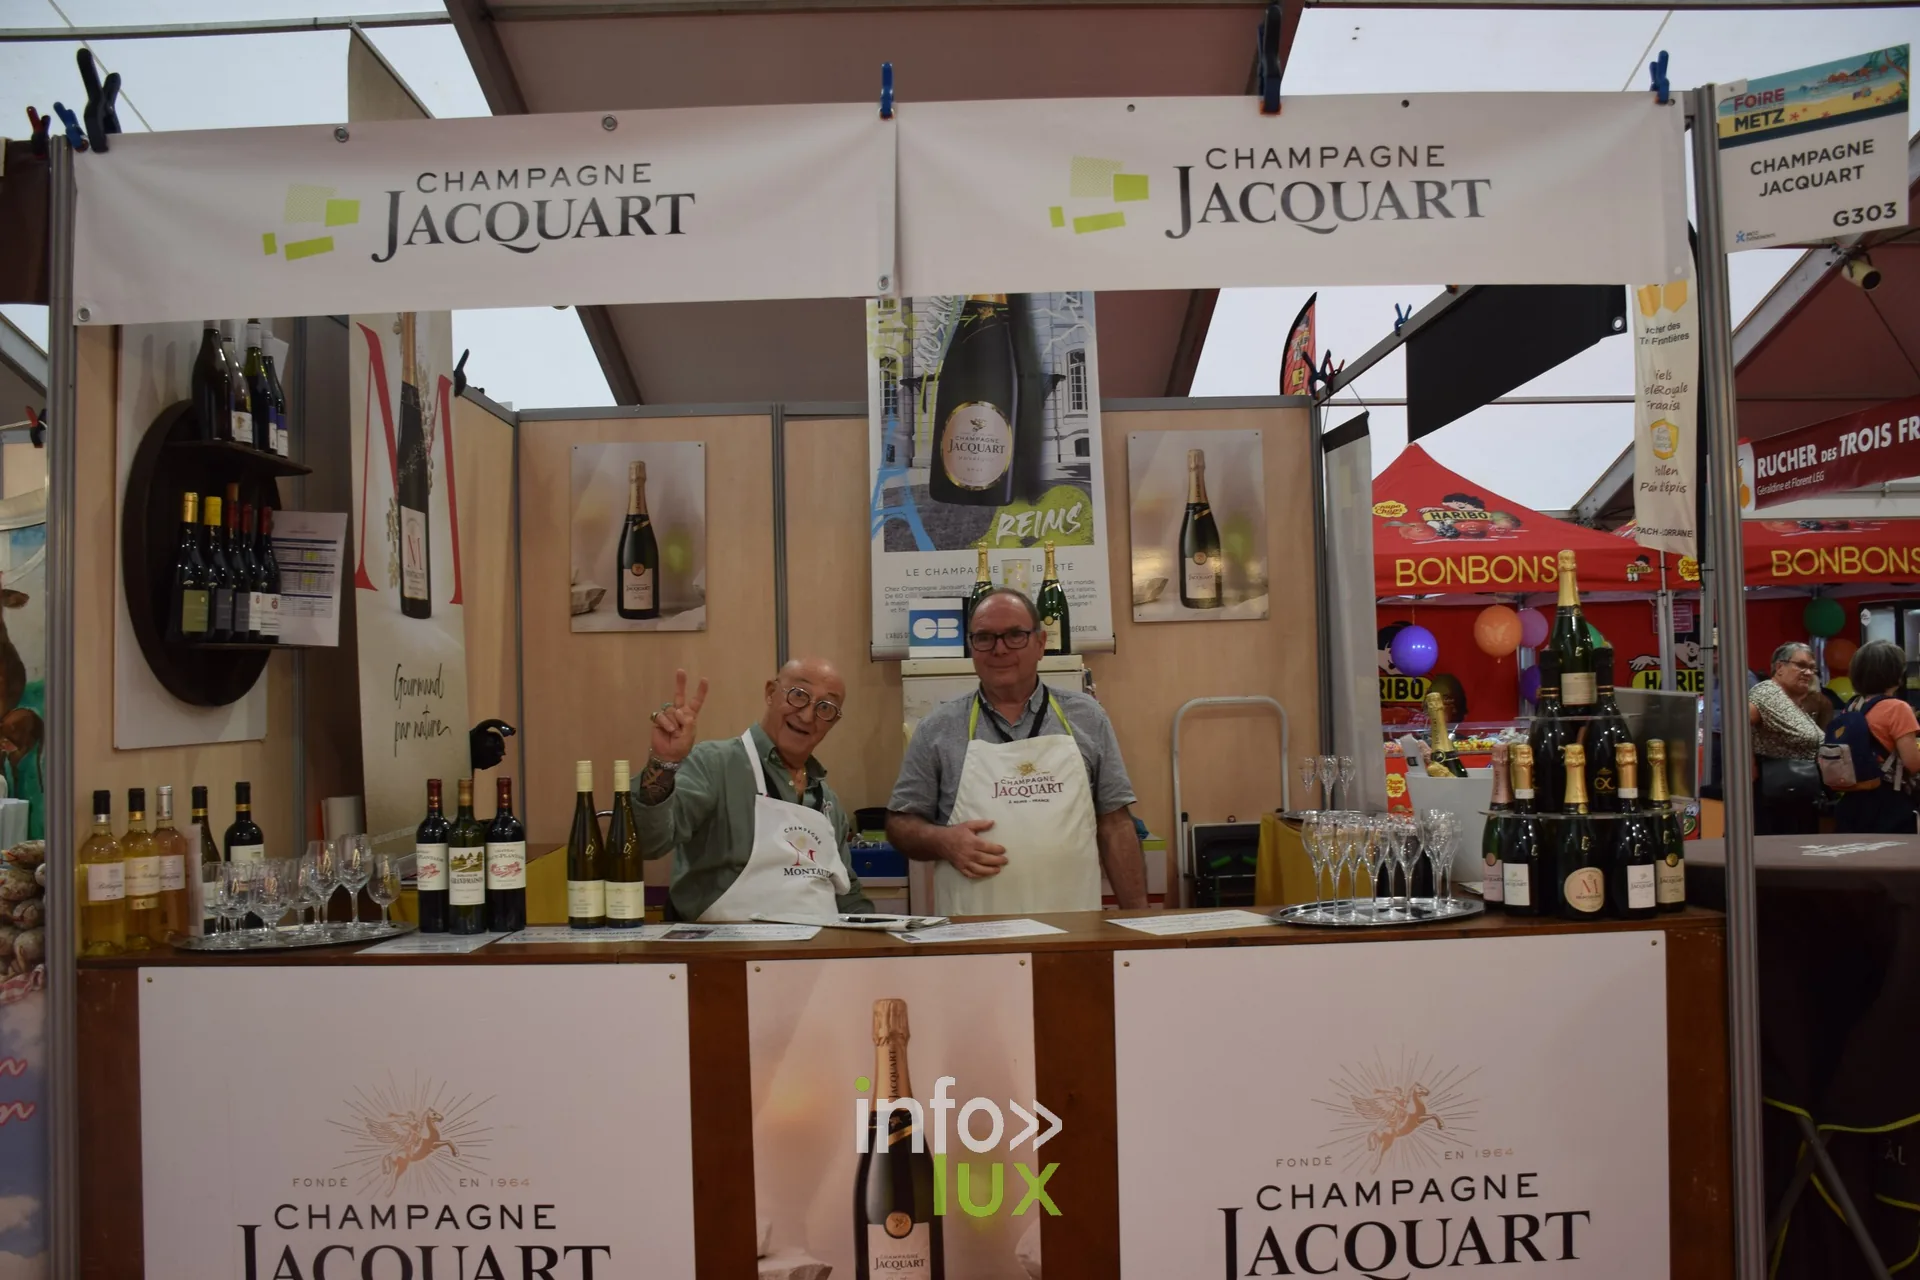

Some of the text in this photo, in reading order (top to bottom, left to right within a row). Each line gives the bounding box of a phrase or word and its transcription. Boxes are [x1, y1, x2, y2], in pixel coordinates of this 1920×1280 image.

[1734, 108, 1785, 132] METZ
[1205, 145, 1446, 170] CHAMPAGNE
[1750, 139, 1875, 175] CHAMPAGNE
[416, 163, 652, 193] CHAMPAGNE
[1759, 164, 1865, 197] JACQUART
[1165, 165, 1492, 240] JACQUART
[1833, 202, 1897, 227] G303
[371, 190, 696, 263] JACQUART
[946, 438, 1006, 454] JACQUART
[1757, 444, 1818, 479] RUCHER
[1821, 447, 1838, 464] DES
[1839, 422, 1893, 459] TROIS
[995, 501, 1083, 546] REIMS
[1430, 511, 1488, 520] HARIBO
[906, 568, 920, 577] LE
[1395, 555, 1558, 586] BONBONS
[1771, 546, 1920, 577] BONBONS
[991, 782, 1064, 798] JACQUART
[1000, 775, 1056, 785] CHAMPAGNE
[783, 825, 822, 846] CHAMPAGNE
[888, 1049, 901, 1101] JACQUART
[1275, 1147, 1515, 1168] FONDÉ EN 1964
[293, 1176, 531, 1188] FONDÉ EN 1964
[1256, 1173, 1539, 1212] CHAMPAGNE
[274, 1204, 557, 1231] CHAMPAGNE
[237, 1224, 612, 1280] JACQUART
[1217, 1210, 1591, 1280] JACQUART
[874, 1257, 926, 1270] JACQUART
